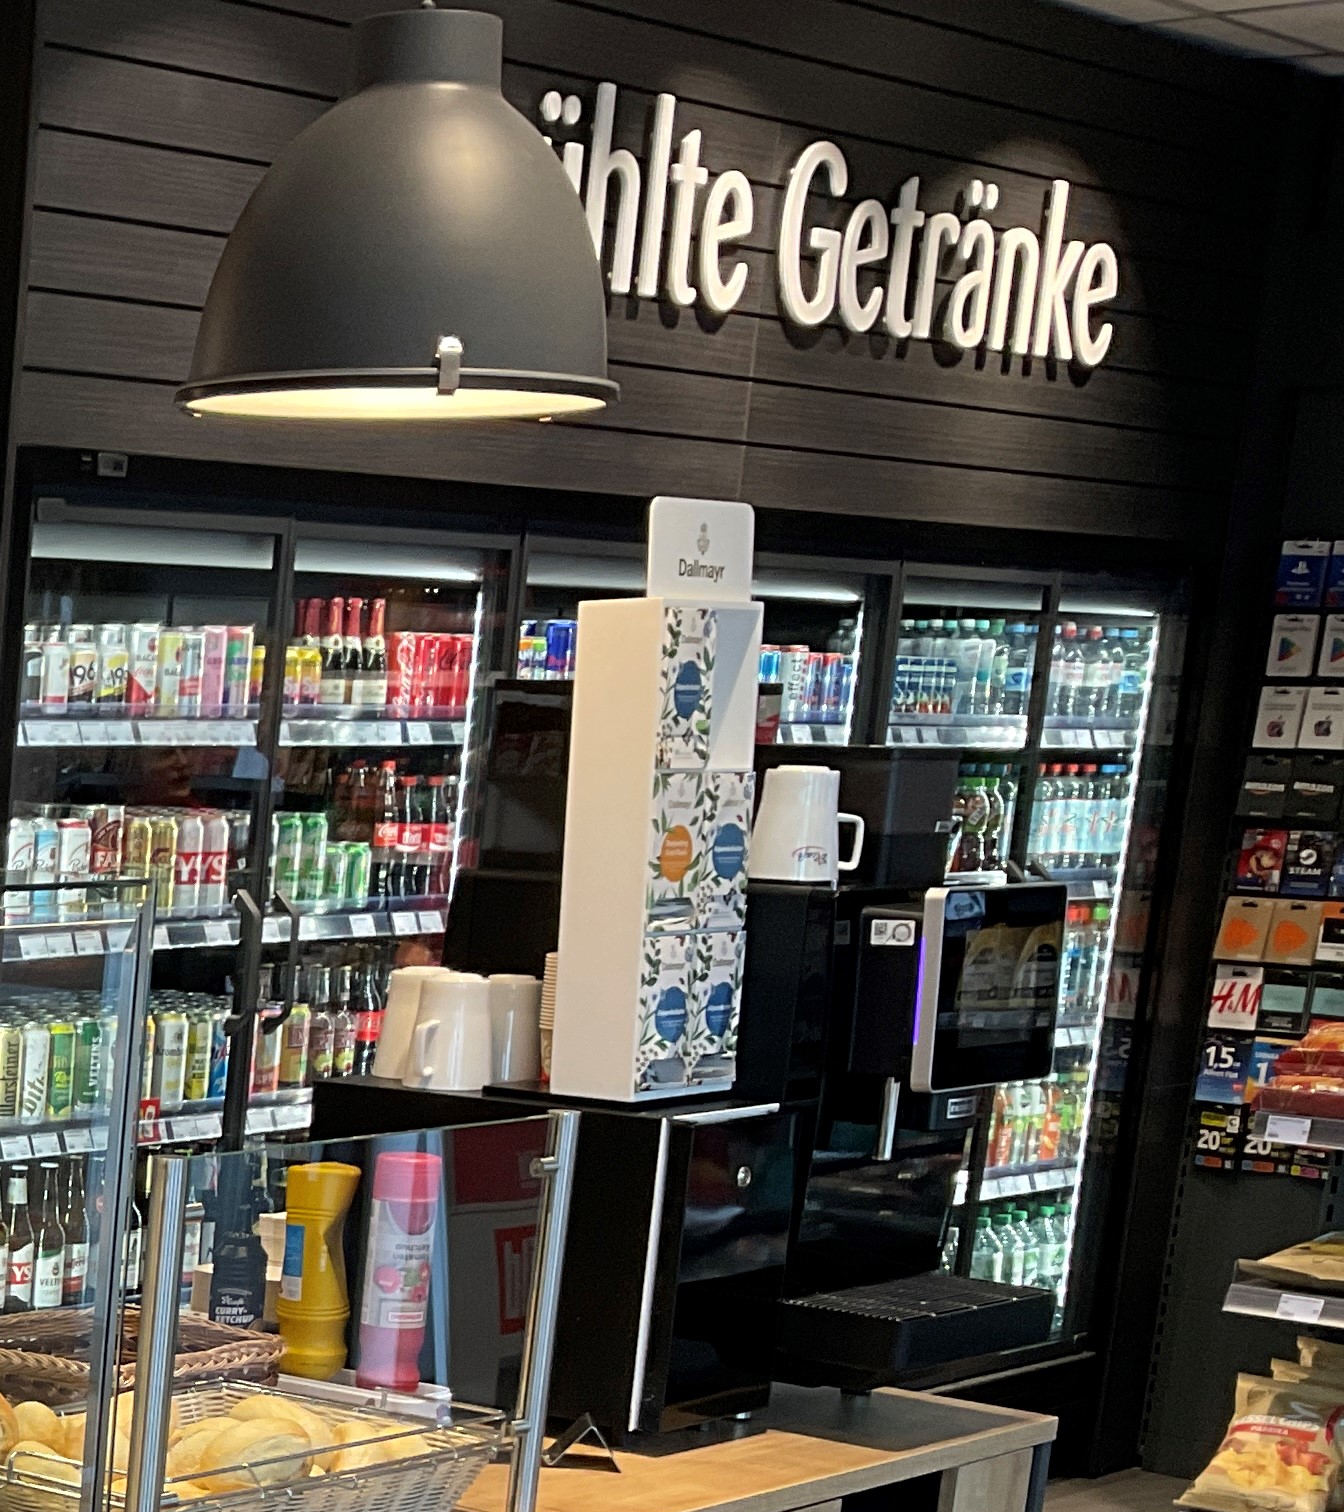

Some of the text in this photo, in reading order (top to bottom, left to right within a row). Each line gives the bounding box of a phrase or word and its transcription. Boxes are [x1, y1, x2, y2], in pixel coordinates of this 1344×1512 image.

[779, 140, 1119, 368] Getränke
[678, 558, 725, 581] Dallmayr
[787, 657, 802, 699] effect
[1288, 864, 1322, 877] STEAM
[0, 1041, 19, 1117] Warsteiner
